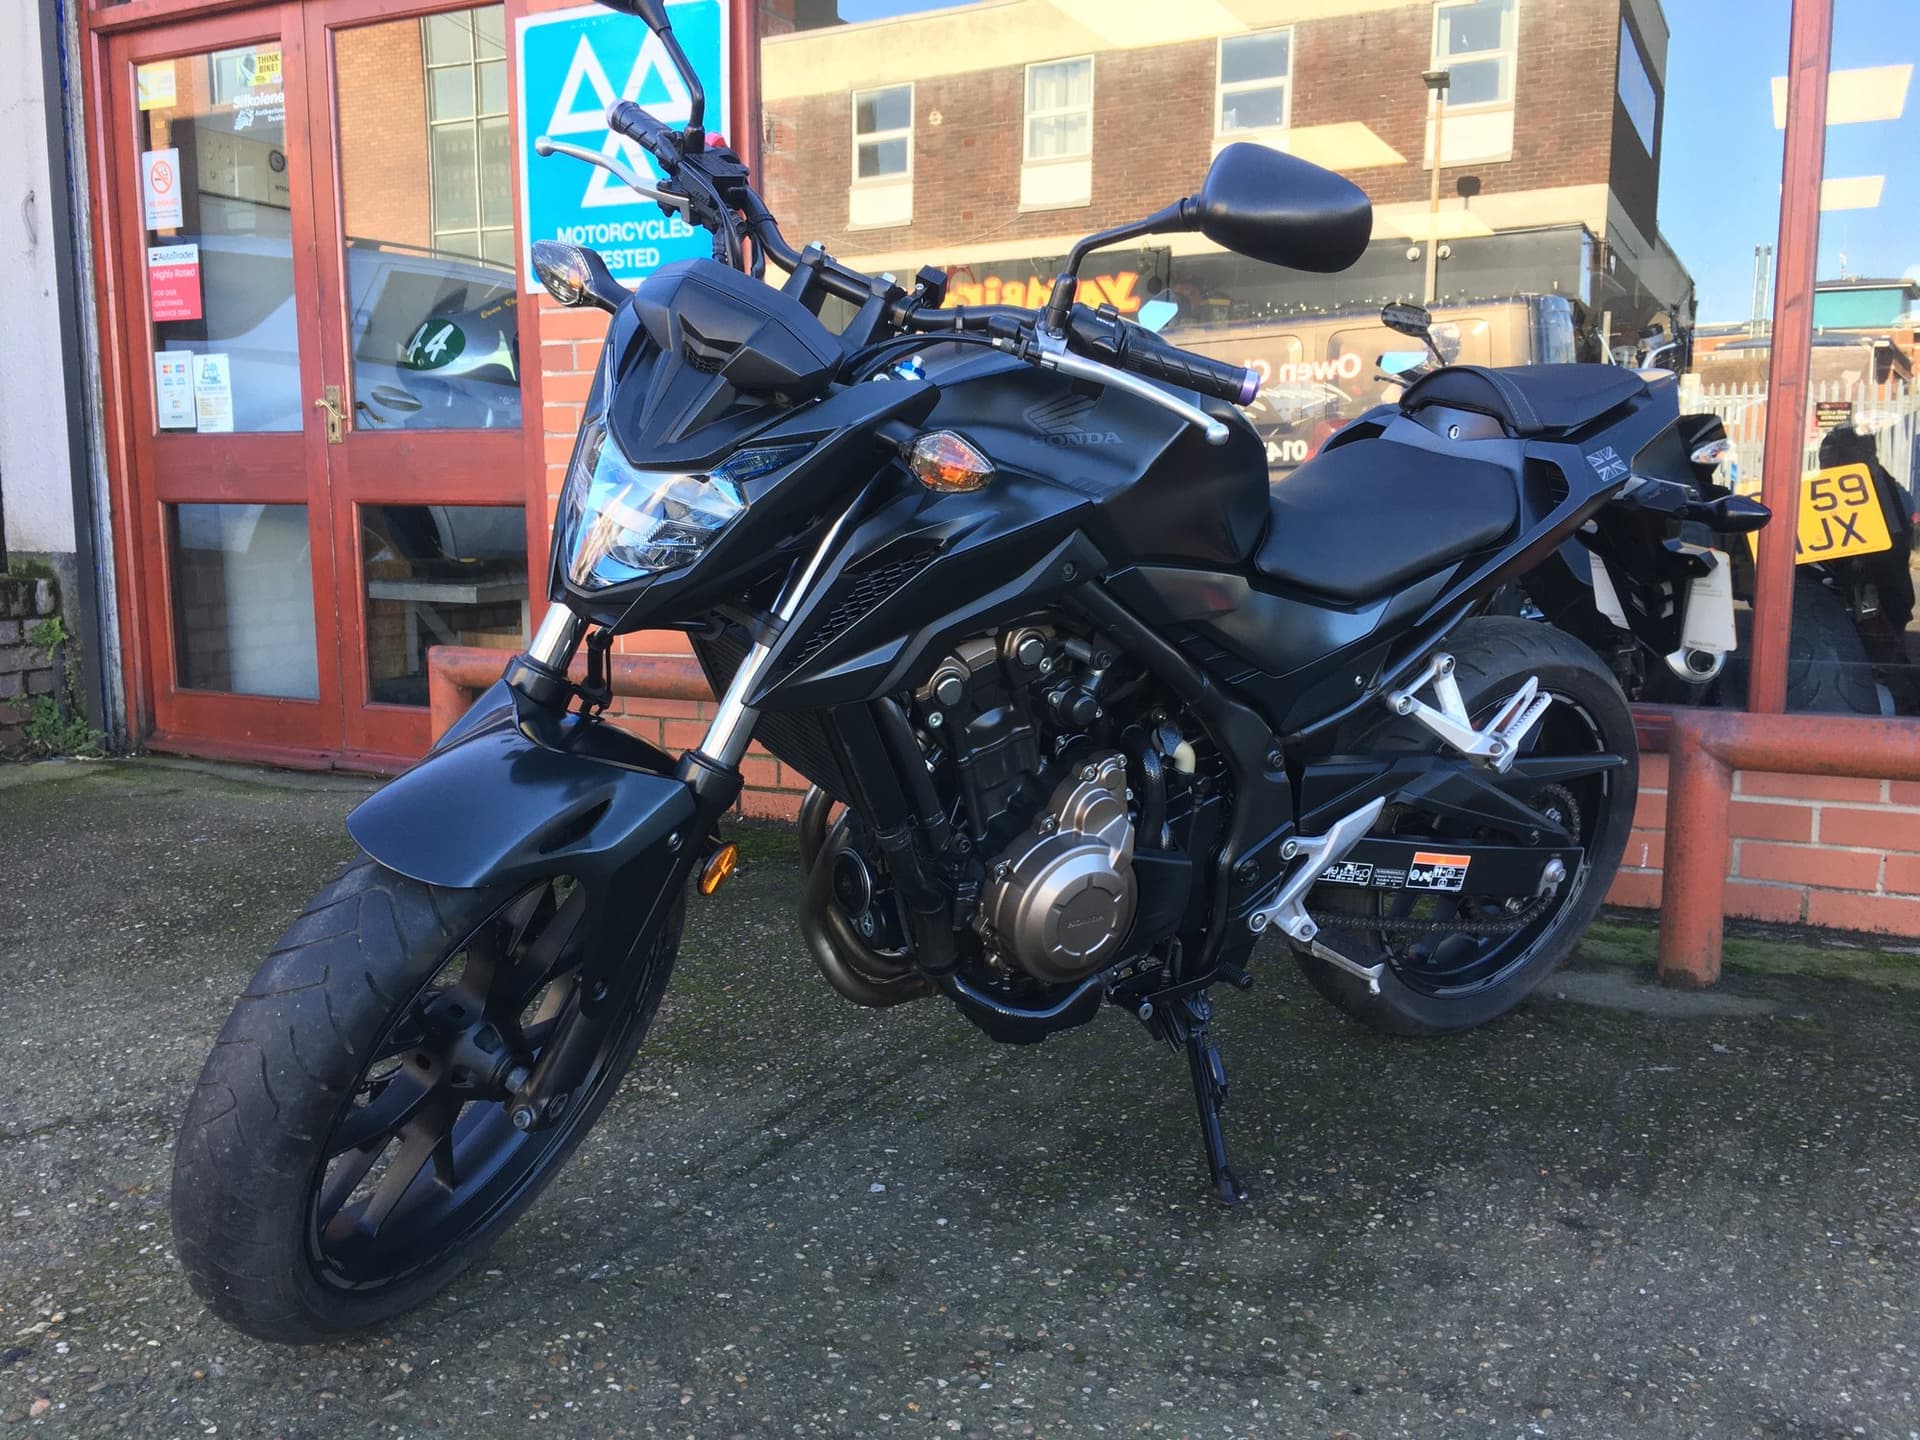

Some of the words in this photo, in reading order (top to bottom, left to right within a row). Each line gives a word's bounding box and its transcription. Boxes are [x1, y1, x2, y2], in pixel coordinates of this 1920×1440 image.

[256, 54, 280, 65] THINK
[258, 63, 279, 74] BIKE!
[233, 91, 285, 110] Silkolene
[557, 219, 694, 246] MOTORCYCLES
[158, 251, 194, 261] AutoTrader
[600, 247, 660, 270] ESTED
[153, 268, 174, 281] Highly
[175, 266, 196, 278] Rated
